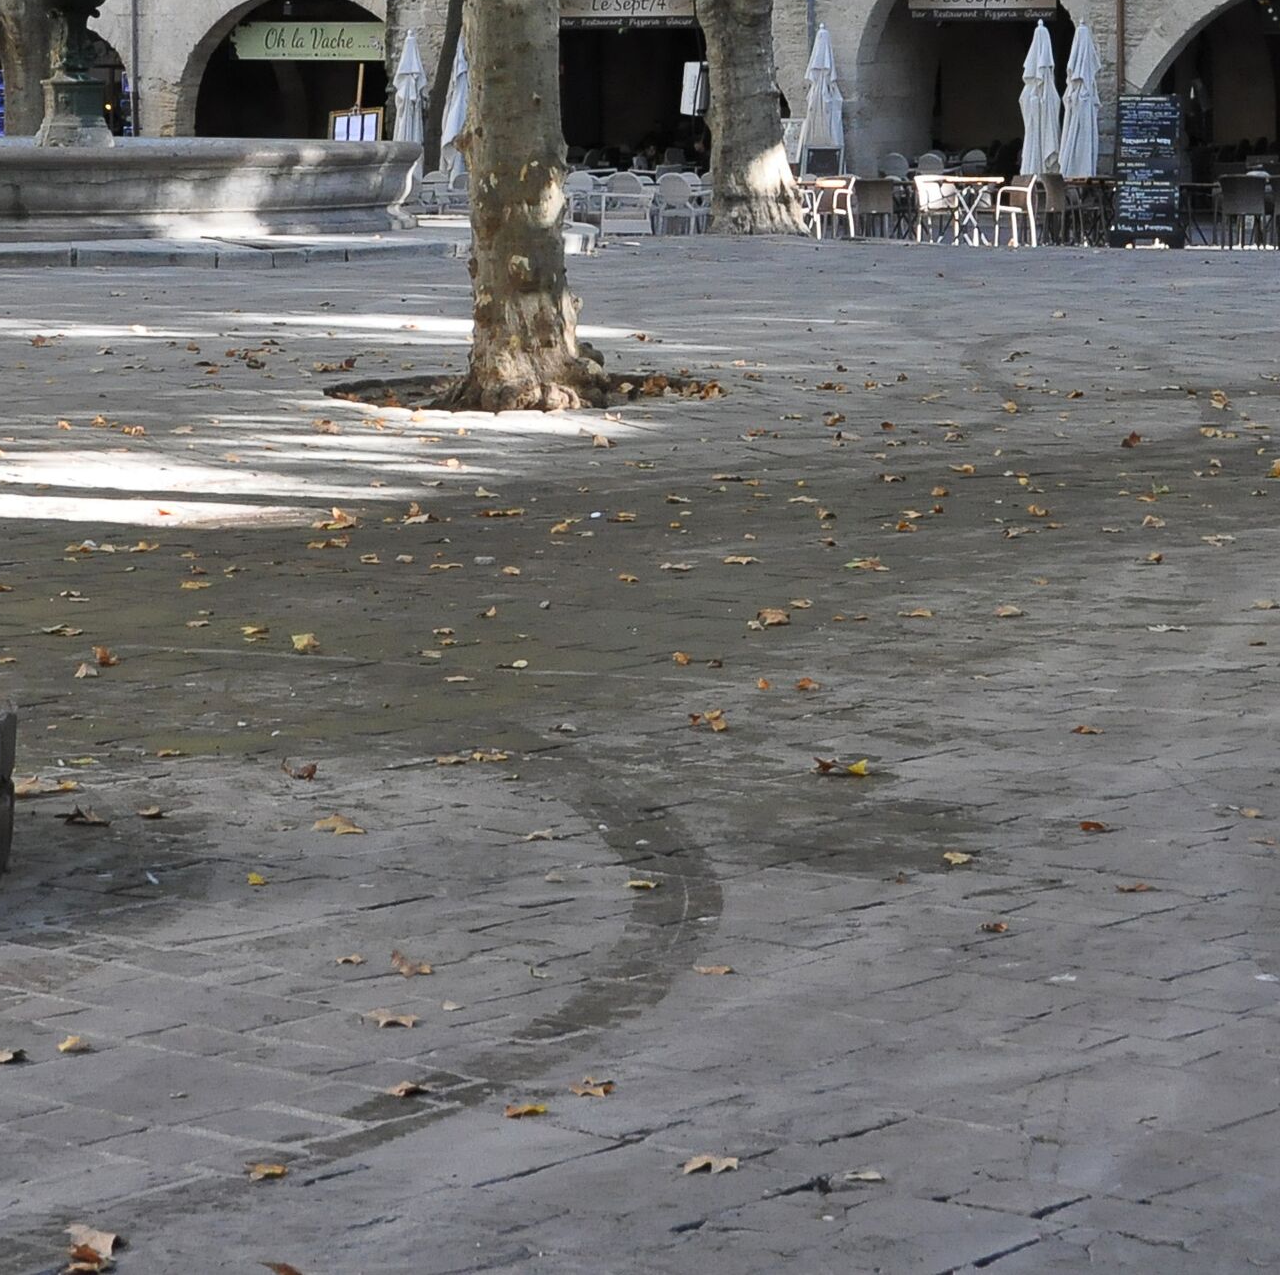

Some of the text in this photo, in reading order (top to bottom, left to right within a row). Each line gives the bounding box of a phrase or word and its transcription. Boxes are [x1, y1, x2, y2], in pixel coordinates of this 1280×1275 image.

[911, 9, 1053, 20] Bar Restaurant Pizzeria Glacier
[581, 18, 623, 26] Restaurant
[628, 19, 660, 27] Pizzeria
[666, 17, 693, 26] Glacier
[264, 27, 286, 50] Oh
[291, 27, 305, 49] la
[310, 27, 354, 50] Vache
